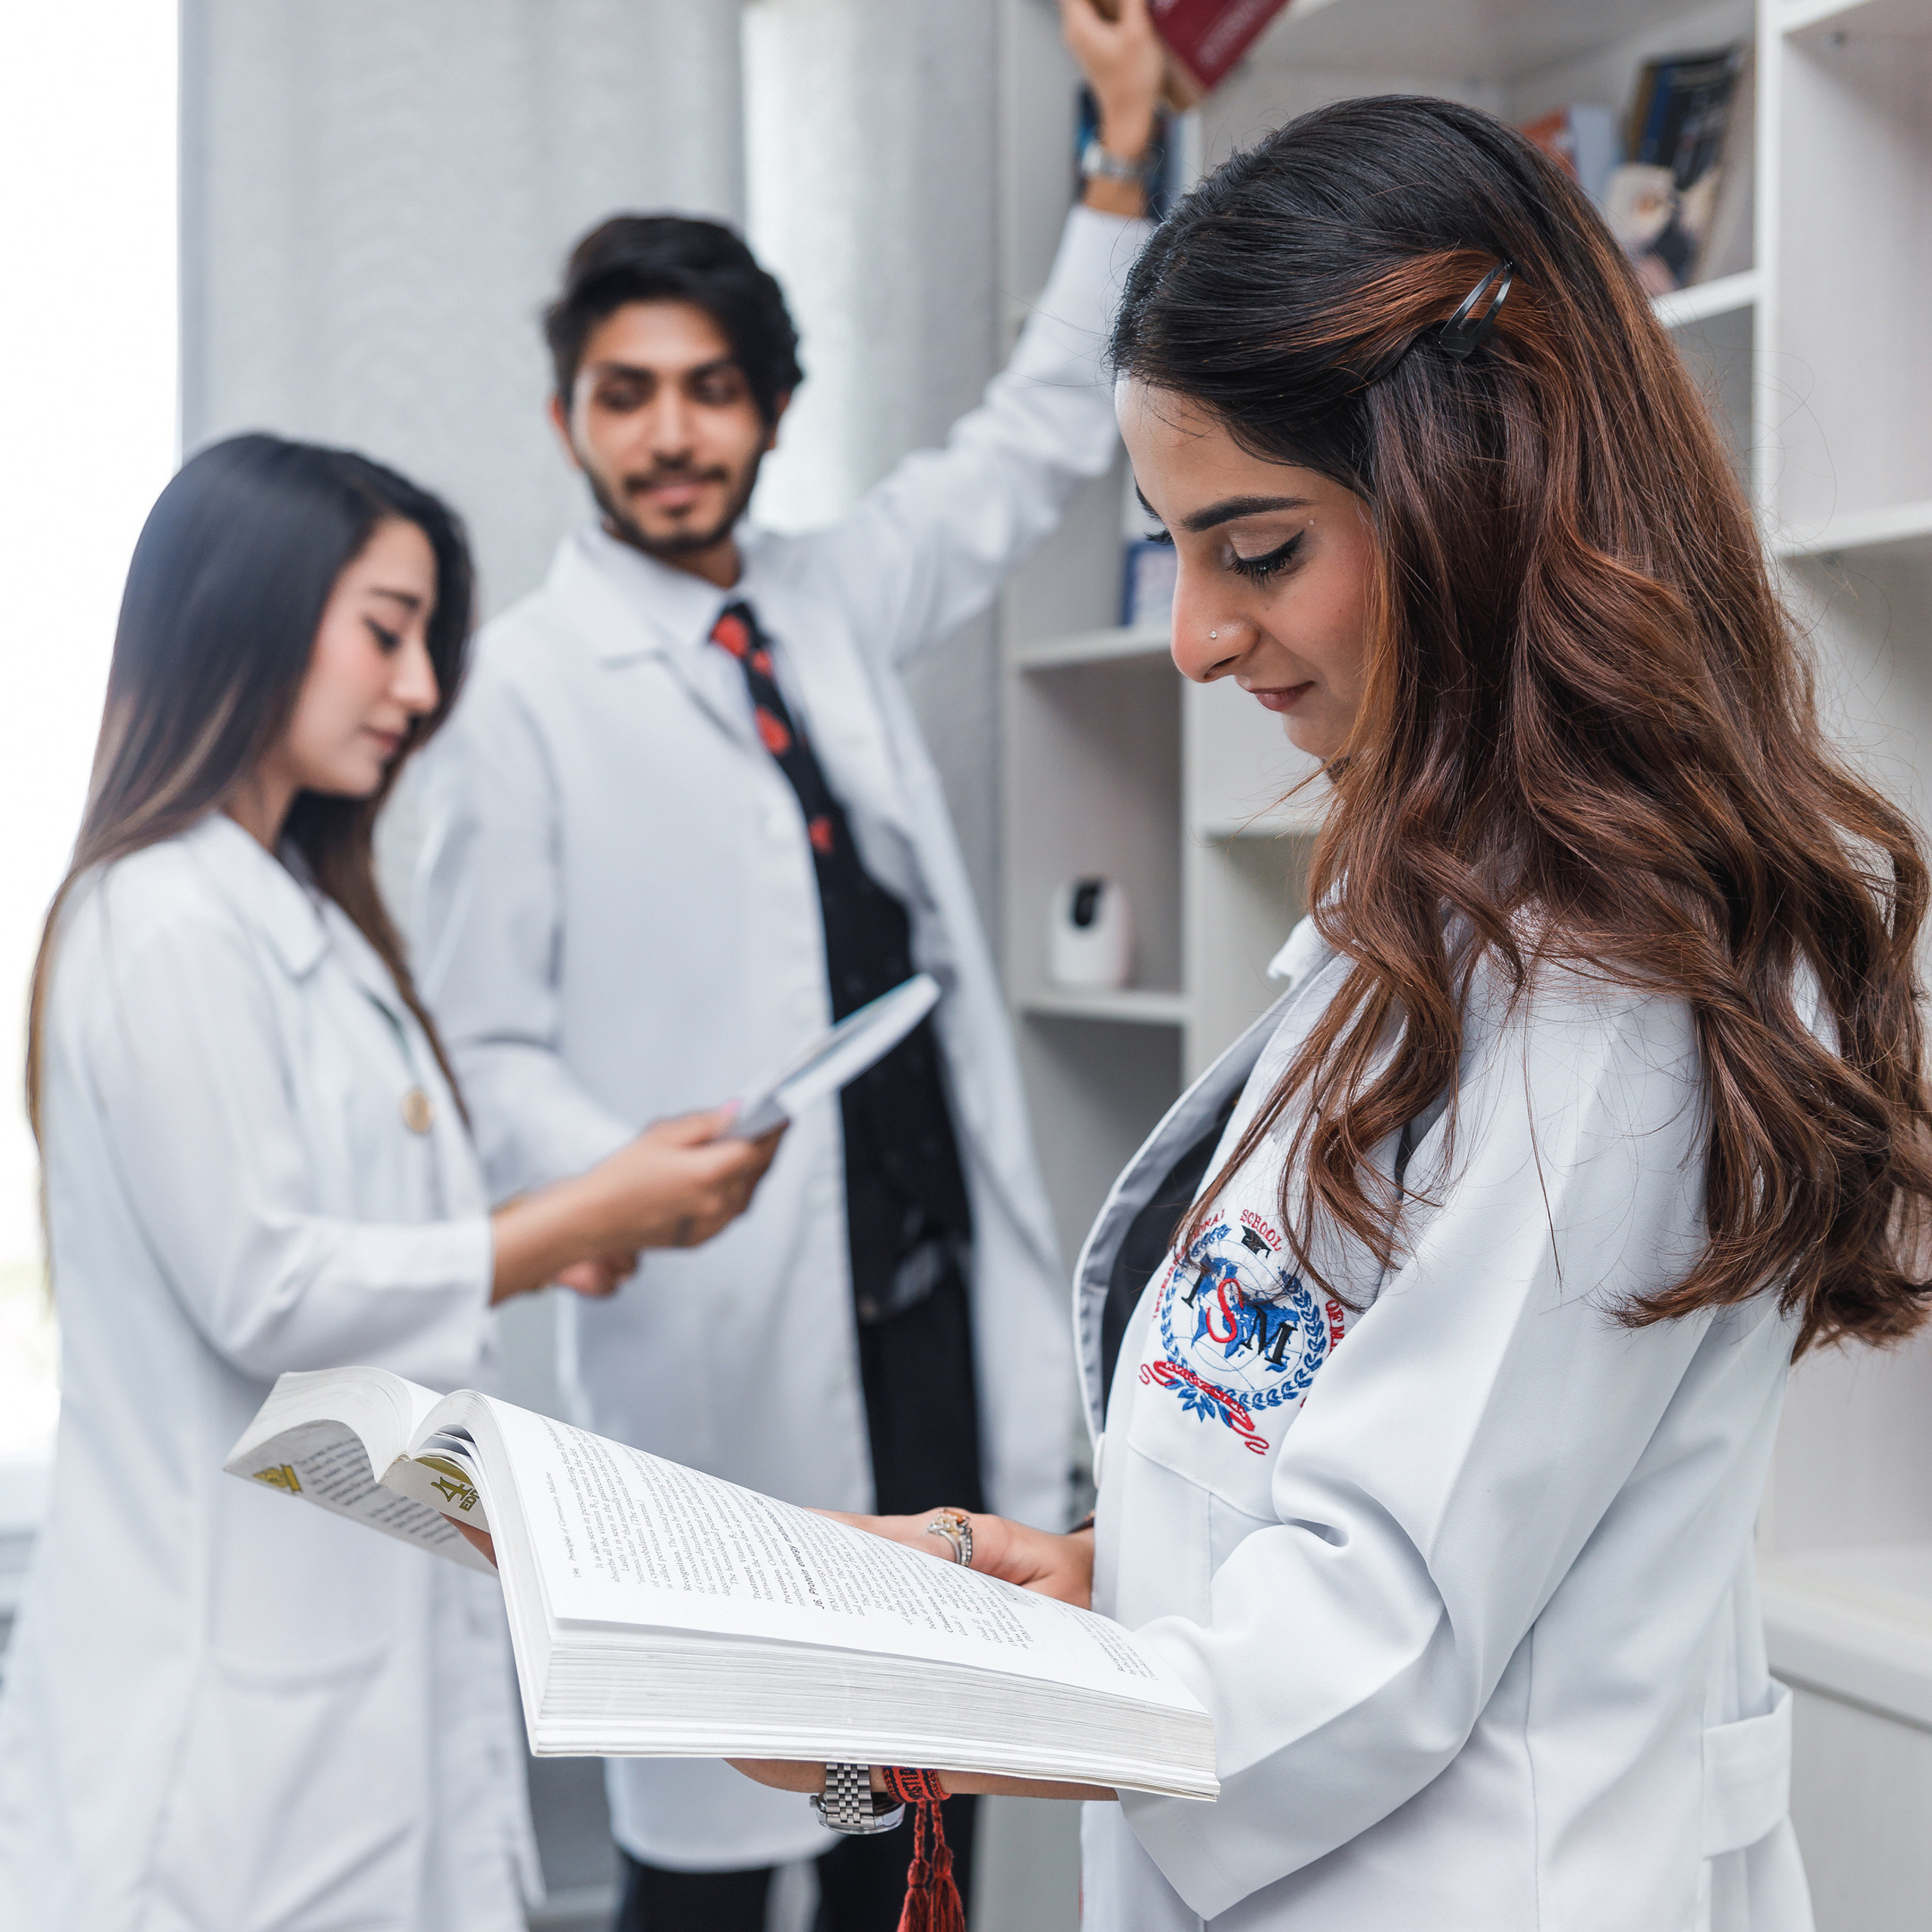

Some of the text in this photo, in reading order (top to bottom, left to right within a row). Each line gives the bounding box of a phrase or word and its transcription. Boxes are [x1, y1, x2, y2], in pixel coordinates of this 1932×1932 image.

[1239, 1208, 1281, 1251] SCHOOL
[1325, 1299, 1344, 1323] OF
[561, 1452, 571, 1465] from
[574, 1460, 583, 1468] the
[546, 1472, 557, 1494] Medicine
[566, 1466, 580, 1491] suffering
[581, 1477, 597, 1497] present
[605, 1478, 617, 1496] occurs
[615, 1475, 625, 1485] that
[431, 1476, 472, 1503] 4
[620, 1487, 634, 1509] anaemia
[553, 1496, 566, 1527] Community
[575, 1493, 590, 1515] persons
[602, 1503, 611, 1513] the
[611, 1497, 626, 1522] normally
[653, 1498, 668, 1516] picture
[592, 1511, 605, 1534] vitamin
[610, 1524, 619, 1537] seen
[621, 1524, 631, 1535] that
[658, 1516, 673, 1537] clinical
[675, 1524, 684, 1535] acts
[586, 1527, 595, 1540] seen
[601, 1537, 609, 1547] the
[668, 1537, 677, 1548] The
[703, 1537, 712, 1546] the
[564, 1536, 576, 1561] Principles
[589, 1542, 598, 1554] also
[602, 1549, 612, 1557] all
[648, 1530, 666, 1562] pernicious
[705, 1547, 715, 1555] of
[617, 1554, 629, 1571] Lastly
[752, 1558, 761, 1567] the
[788, 1544, 804, 1567] energy
[607, 1558, 620, 1583] absorbs
[657, 1564, 670, 1582] called
[674, 1550, 691, 1591] Recognition.
[700, 1558, 713, 1581] sensory
[707, 1557, 731, 1596] degeneration
[649, 1580, 660, 1588] of
[728, 1574, 738, 1585] The
[743, 1566, 761, 1599] Treatment.
[774, 1568, 792, 1604] Prevention.
[801, 1570, 818, 1595] Protein
[694, 1585, 705, 1593] of
[708, 1583, 718, 1595] like
